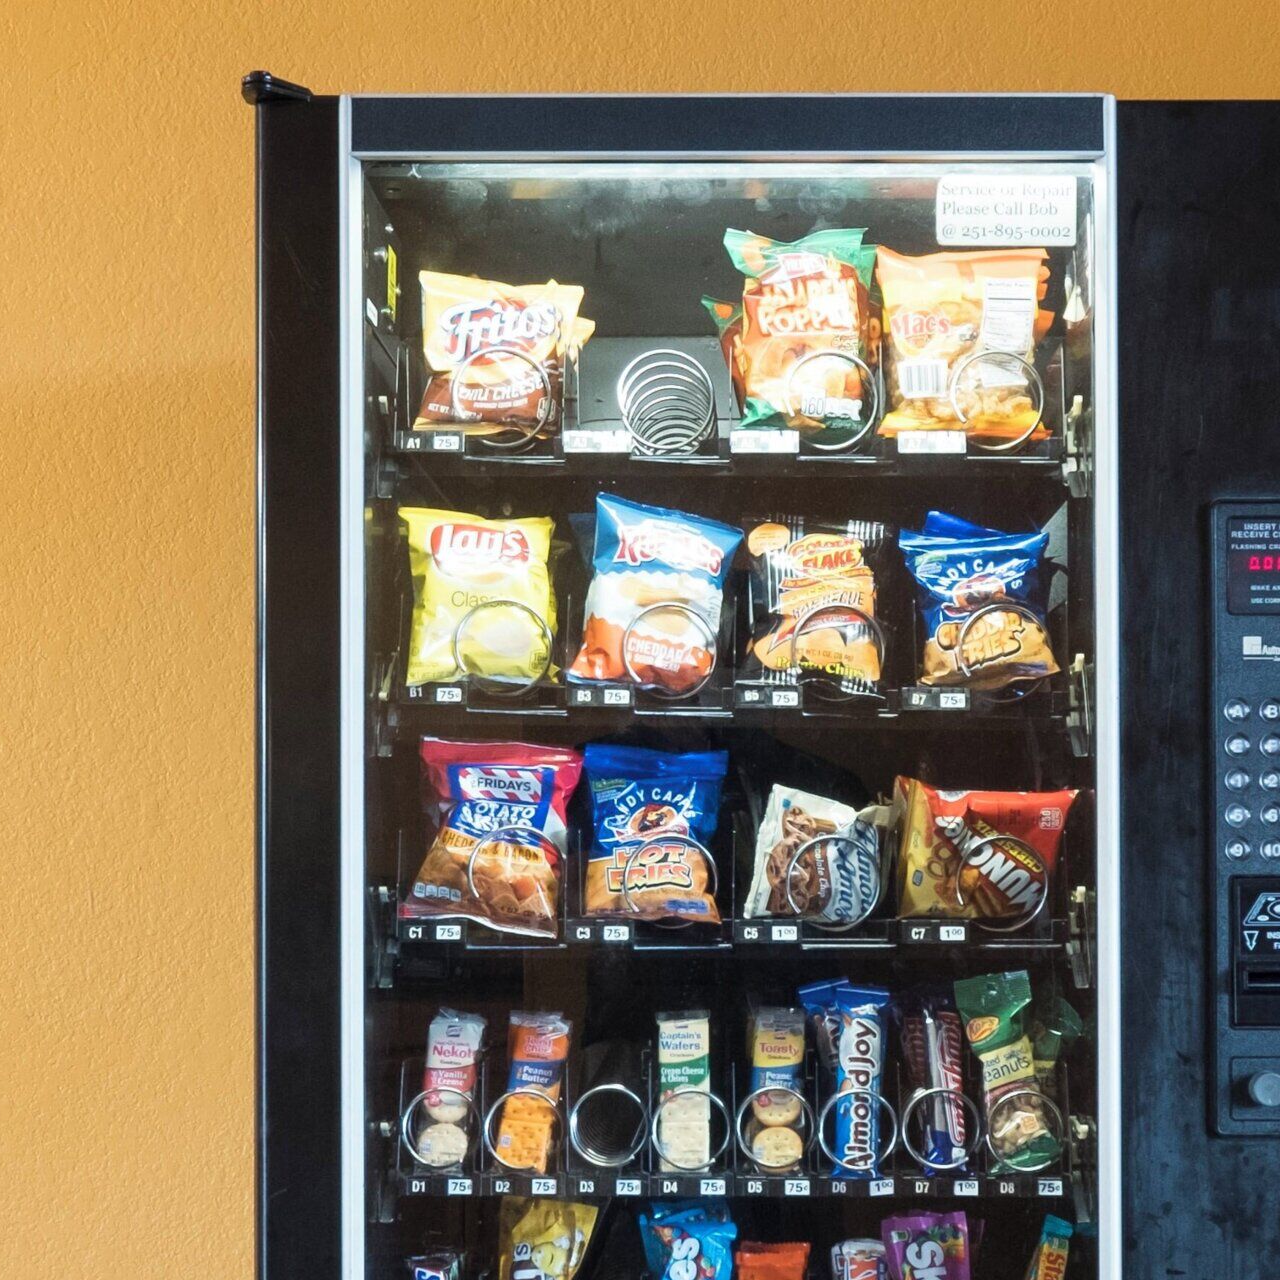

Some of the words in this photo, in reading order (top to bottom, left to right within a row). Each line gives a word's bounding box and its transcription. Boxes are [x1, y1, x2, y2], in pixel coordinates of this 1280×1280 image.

[942, 183, 997, 197] Service
[1001, 187, 1014, 197] or
[1022, 183, 1072, 199] Repair
[942, 202, 990, 215] Please
[994, 201, 1023, 215] Call
[1029, 202, 1058, 215] Bob
[942, 225, 956, 239] @
[962, 224, 1071, 240] 251-895-0002
[406, 437, 421, 449] A1
[1244, 523, 1277, 531] INSERT
[1231, 531, 1270, 539] RECEIVE
[802, 548, 858, 571] FLAKE
[409, 688, 423, 698] B1
[577, 691, 591, 702] B3
[744, 690, 760, 701] B5
[911, 694, 926, 705] B7
[478, 776, 531, 792] FRIDAYS
[614, 843, 687, 866] HOT
[606, 862, 692, 893] FRIES
[408, 926, 422, 939] C1
[577, 928, 591, 939] C3
[744, 927, 759, 939] C5
[911, 928, 926, 940] C7
[660, 1032, 702, 1042] Captain's
[661, 1041, 701, 1051] Wafers
[848, 1018, 877, 1068] Joy
[759, 1043, 799, 1058] Toasty
[439, 1070, 468, 1080] Vanilla
[523, 1066, 553, 1077] Peanut
[661, 1067, 682, 1076] Cream
[682, 1067, 704, 1075] Cheese
[437, 1078, 464, 1087] Creme
[521, 1073, 550, 1084] Butter
[667, 1075, 689, 1083] Chives
[411, 1181, 426, 1193] D1
[495, 1182, 511, 1193] D2
[579, 1181, 595, 1193] D3
[663, 1181, 678, 1193] D4
[747, 1181, 763, 1193] D5
[832, 1182, 847, 1193] D6
[915, 1182, 930, 1193] D7
[999, 1182, 1015, 1194] D8
